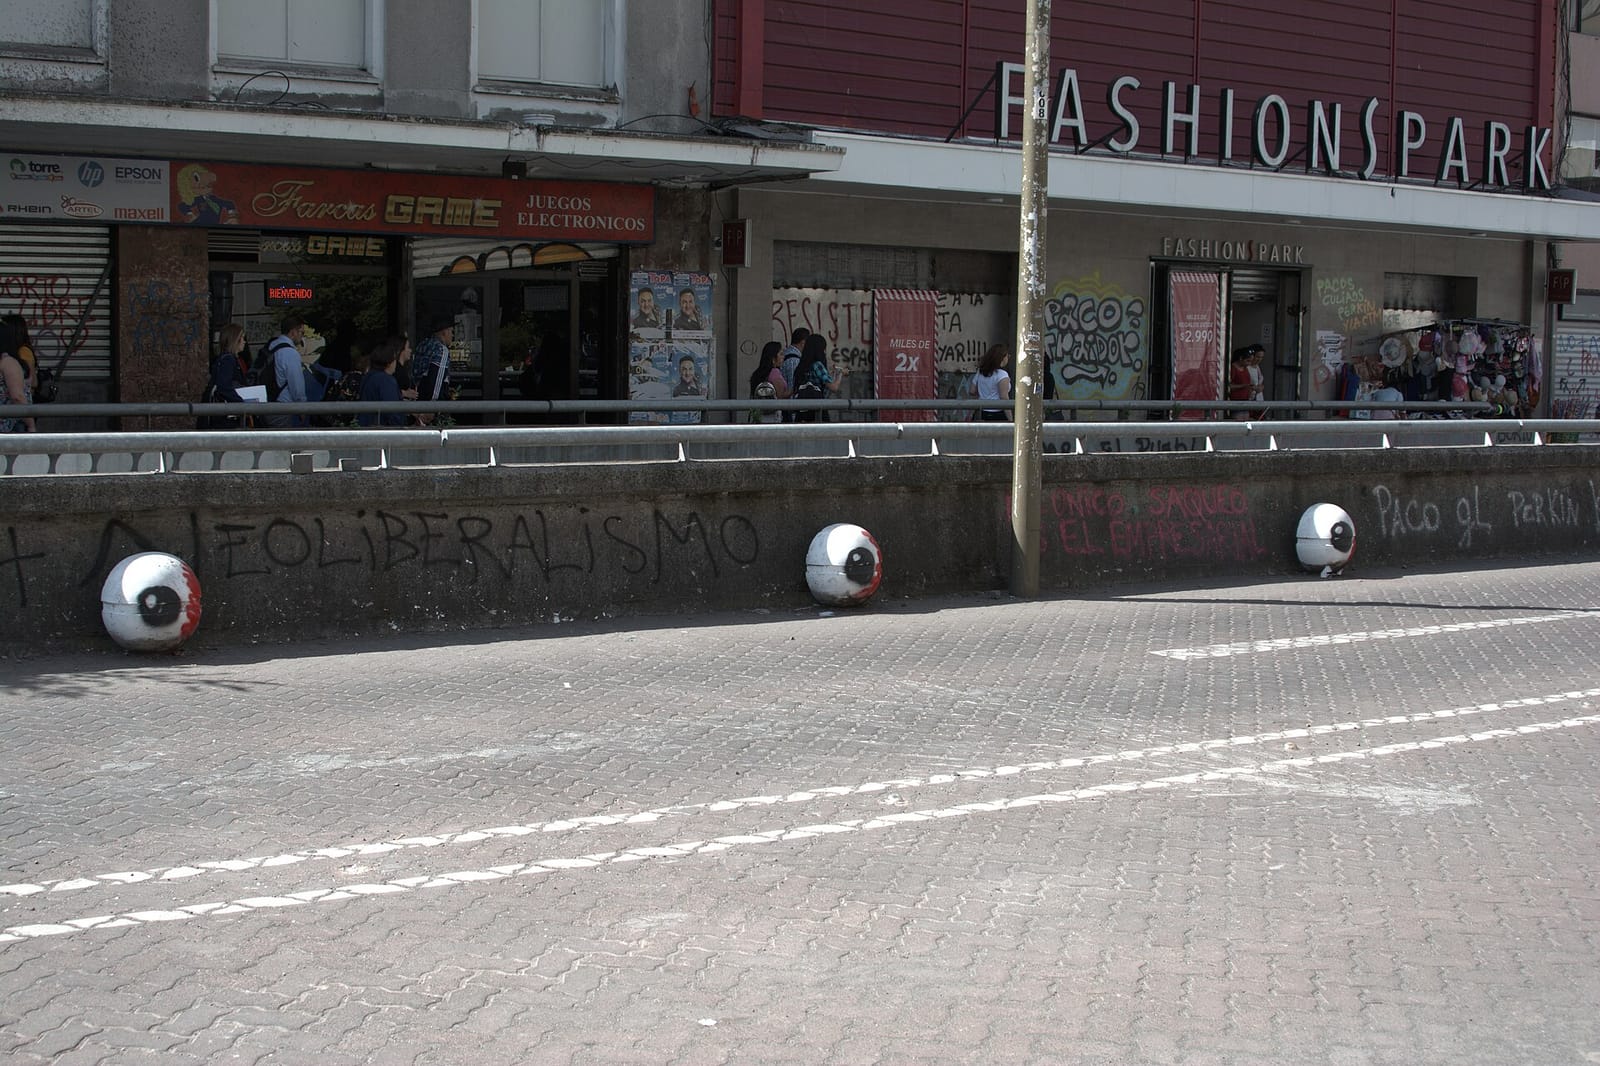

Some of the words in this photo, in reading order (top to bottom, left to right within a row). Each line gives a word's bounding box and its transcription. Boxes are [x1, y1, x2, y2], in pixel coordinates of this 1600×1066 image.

[28, 160, 61, 174] torre
[81, 161, 102, 187] hp
[115, 166, 161, 180] EPSON
[526, 194, 592, 210] JUEGOS
[66, 205, 99, 214] ARTEL
[114, 207, 164, 220] maxell
[383, 193, 503, 228] GAME
[517, 211, 647, 232] ELECTRONICOS
[307, 235, 385, 256] GAME
[268, 288, 313, 300] BIENVENIDO
[889, 338, 917, 349] MILES
[918, 340, 931, 350] DE
